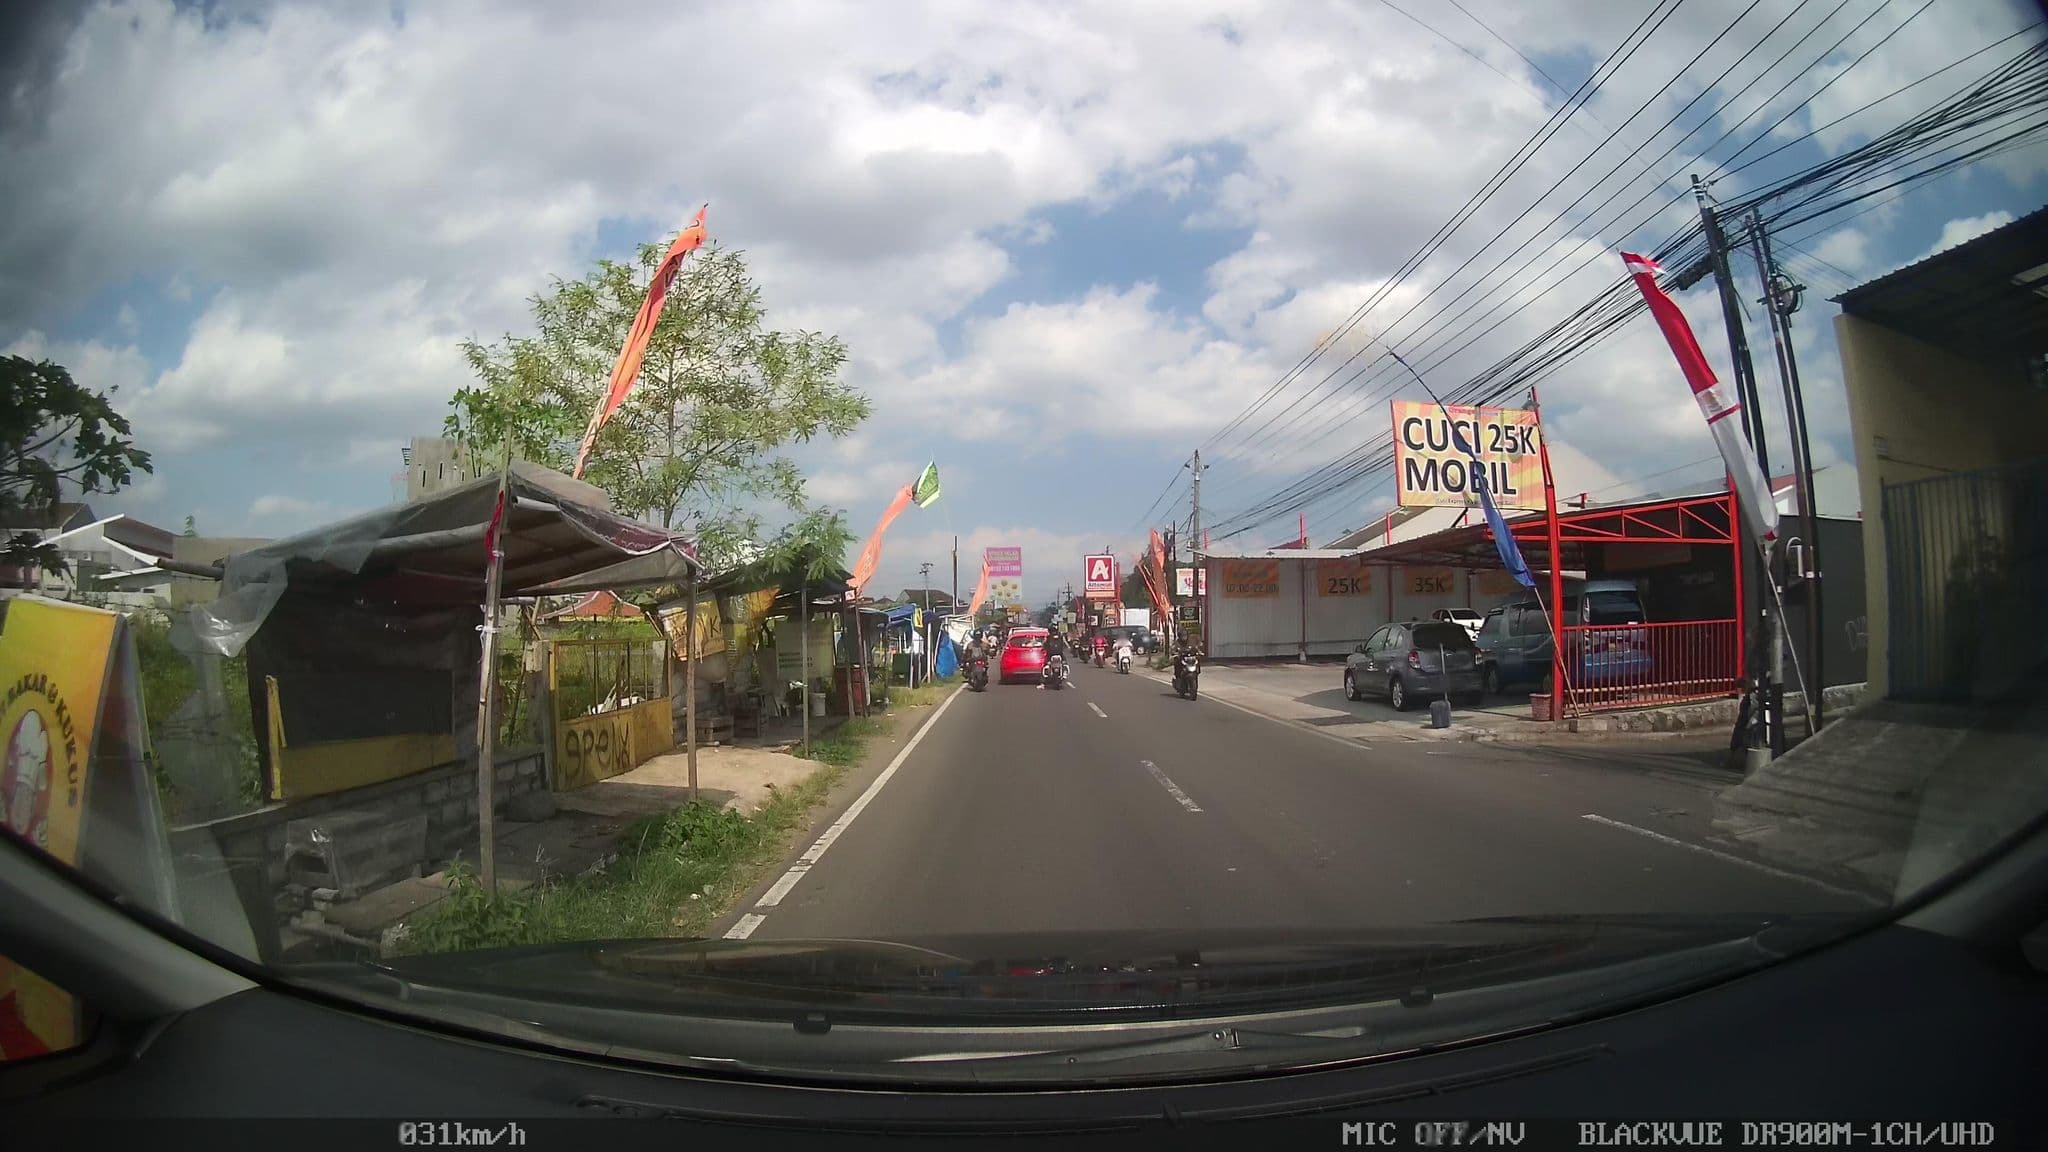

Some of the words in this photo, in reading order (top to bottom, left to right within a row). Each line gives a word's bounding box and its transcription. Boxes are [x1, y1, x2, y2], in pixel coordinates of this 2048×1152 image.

[1403, 417, 1481, 453] CUCI
[1488, 423, 1537, 455] 25K
[1405, 456, 1517, 495] MOBIL
[1327, 577, 1361, 594] 25K
[1414, 576, 1445, 593] 35K
